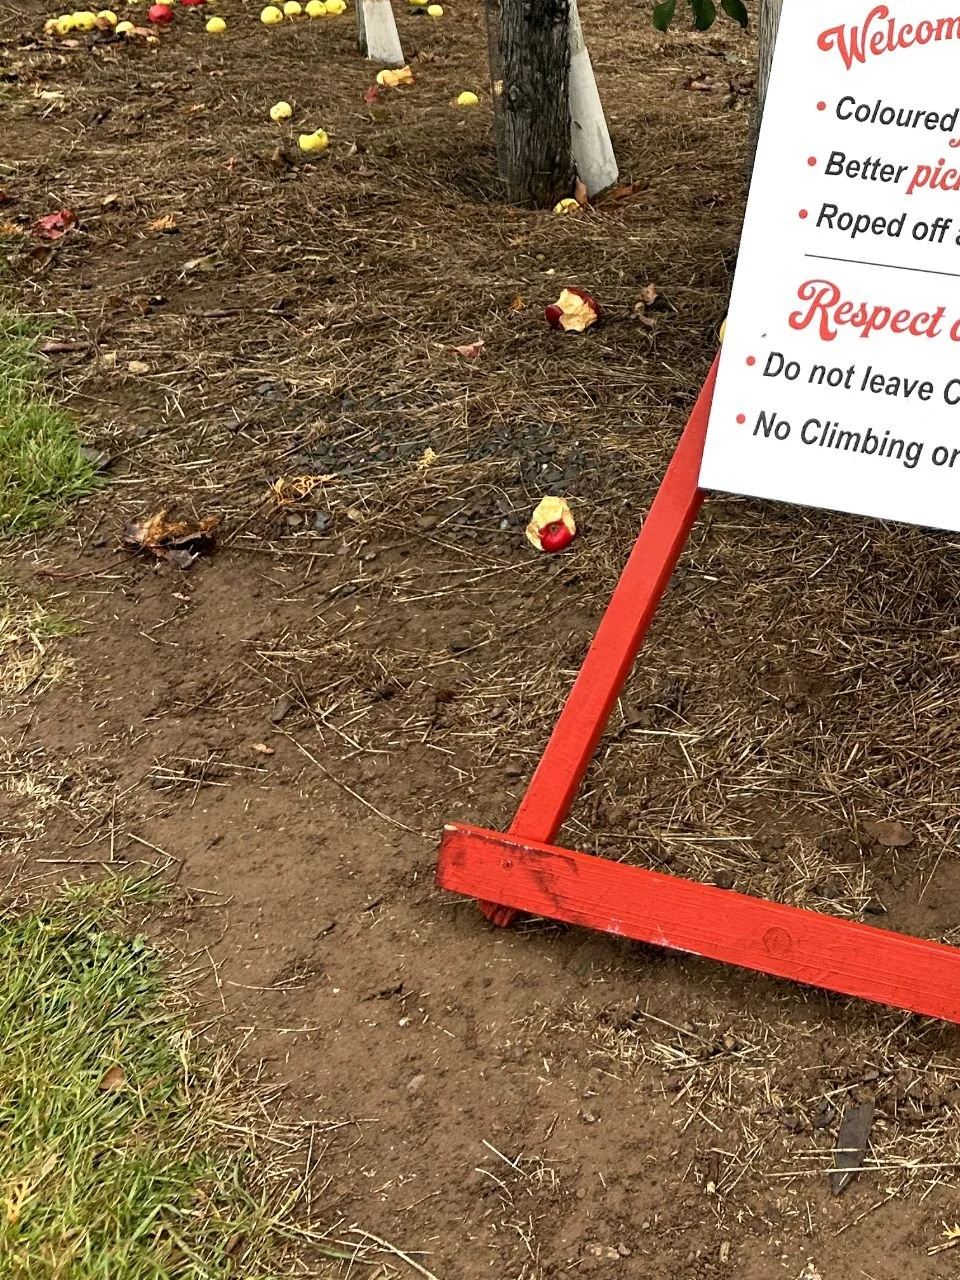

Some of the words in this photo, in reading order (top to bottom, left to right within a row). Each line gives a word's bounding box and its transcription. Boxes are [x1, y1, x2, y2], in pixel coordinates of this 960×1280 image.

[836, 95, 960, 132] Coloured
[824, 150, 908, 184] Better
[815, 202, 907, 239] Roped
[911, 216, 953, 243] off
[788, 279, 947, 342] Respect
[762, 351, 801, 381] Do
[808, 364, 855, 390] not
[860, 365, 934, 401] leave
[752, 410, 791, 441] No
[800, 418, 924, 469] Climbing
